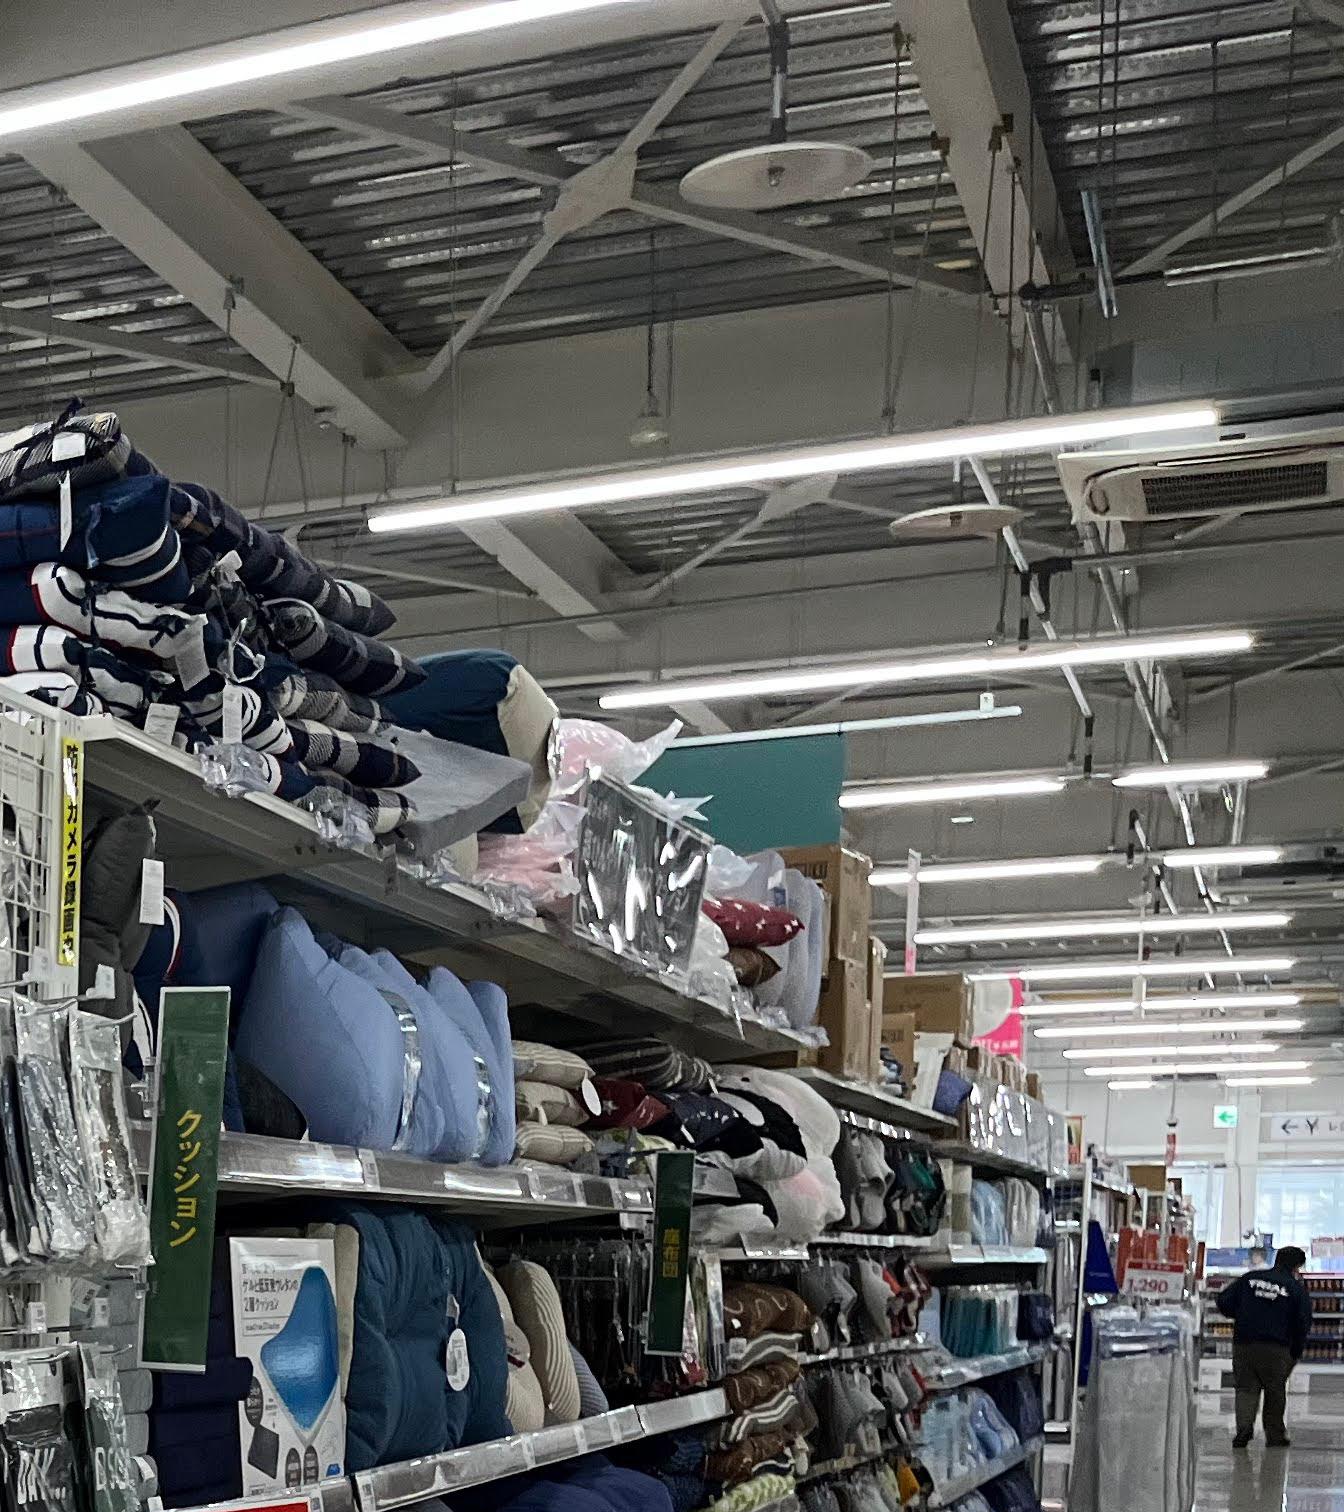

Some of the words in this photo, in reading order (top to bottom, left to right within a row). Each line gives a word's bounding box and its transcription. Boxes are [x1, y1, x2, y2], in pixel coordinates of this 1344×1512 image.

[169, 1108, 202, 1248] クッション
